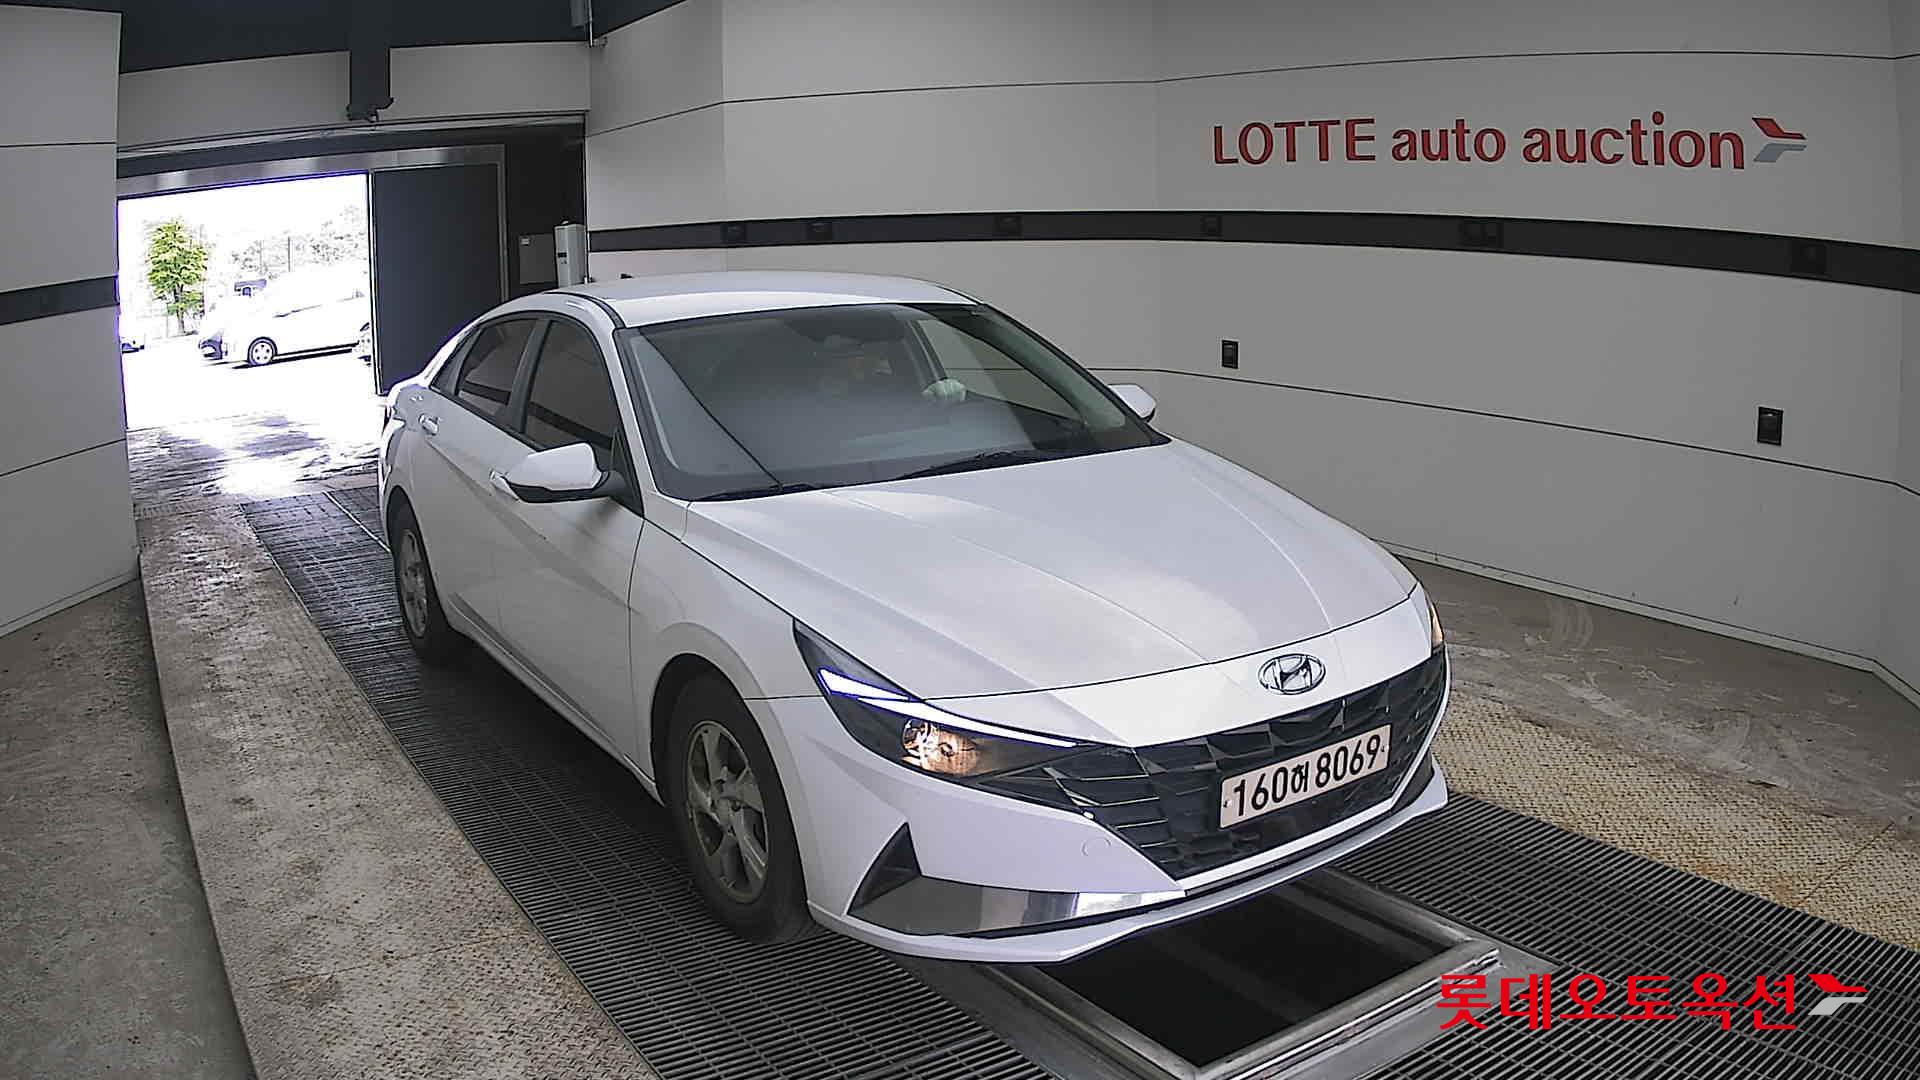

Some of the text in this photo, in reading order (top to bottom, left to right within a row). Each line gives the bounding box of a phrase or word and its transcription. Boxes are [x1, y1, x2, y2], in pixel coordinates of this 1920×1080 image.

[1214, 111, 1745, 169] LOTTE auto auction
